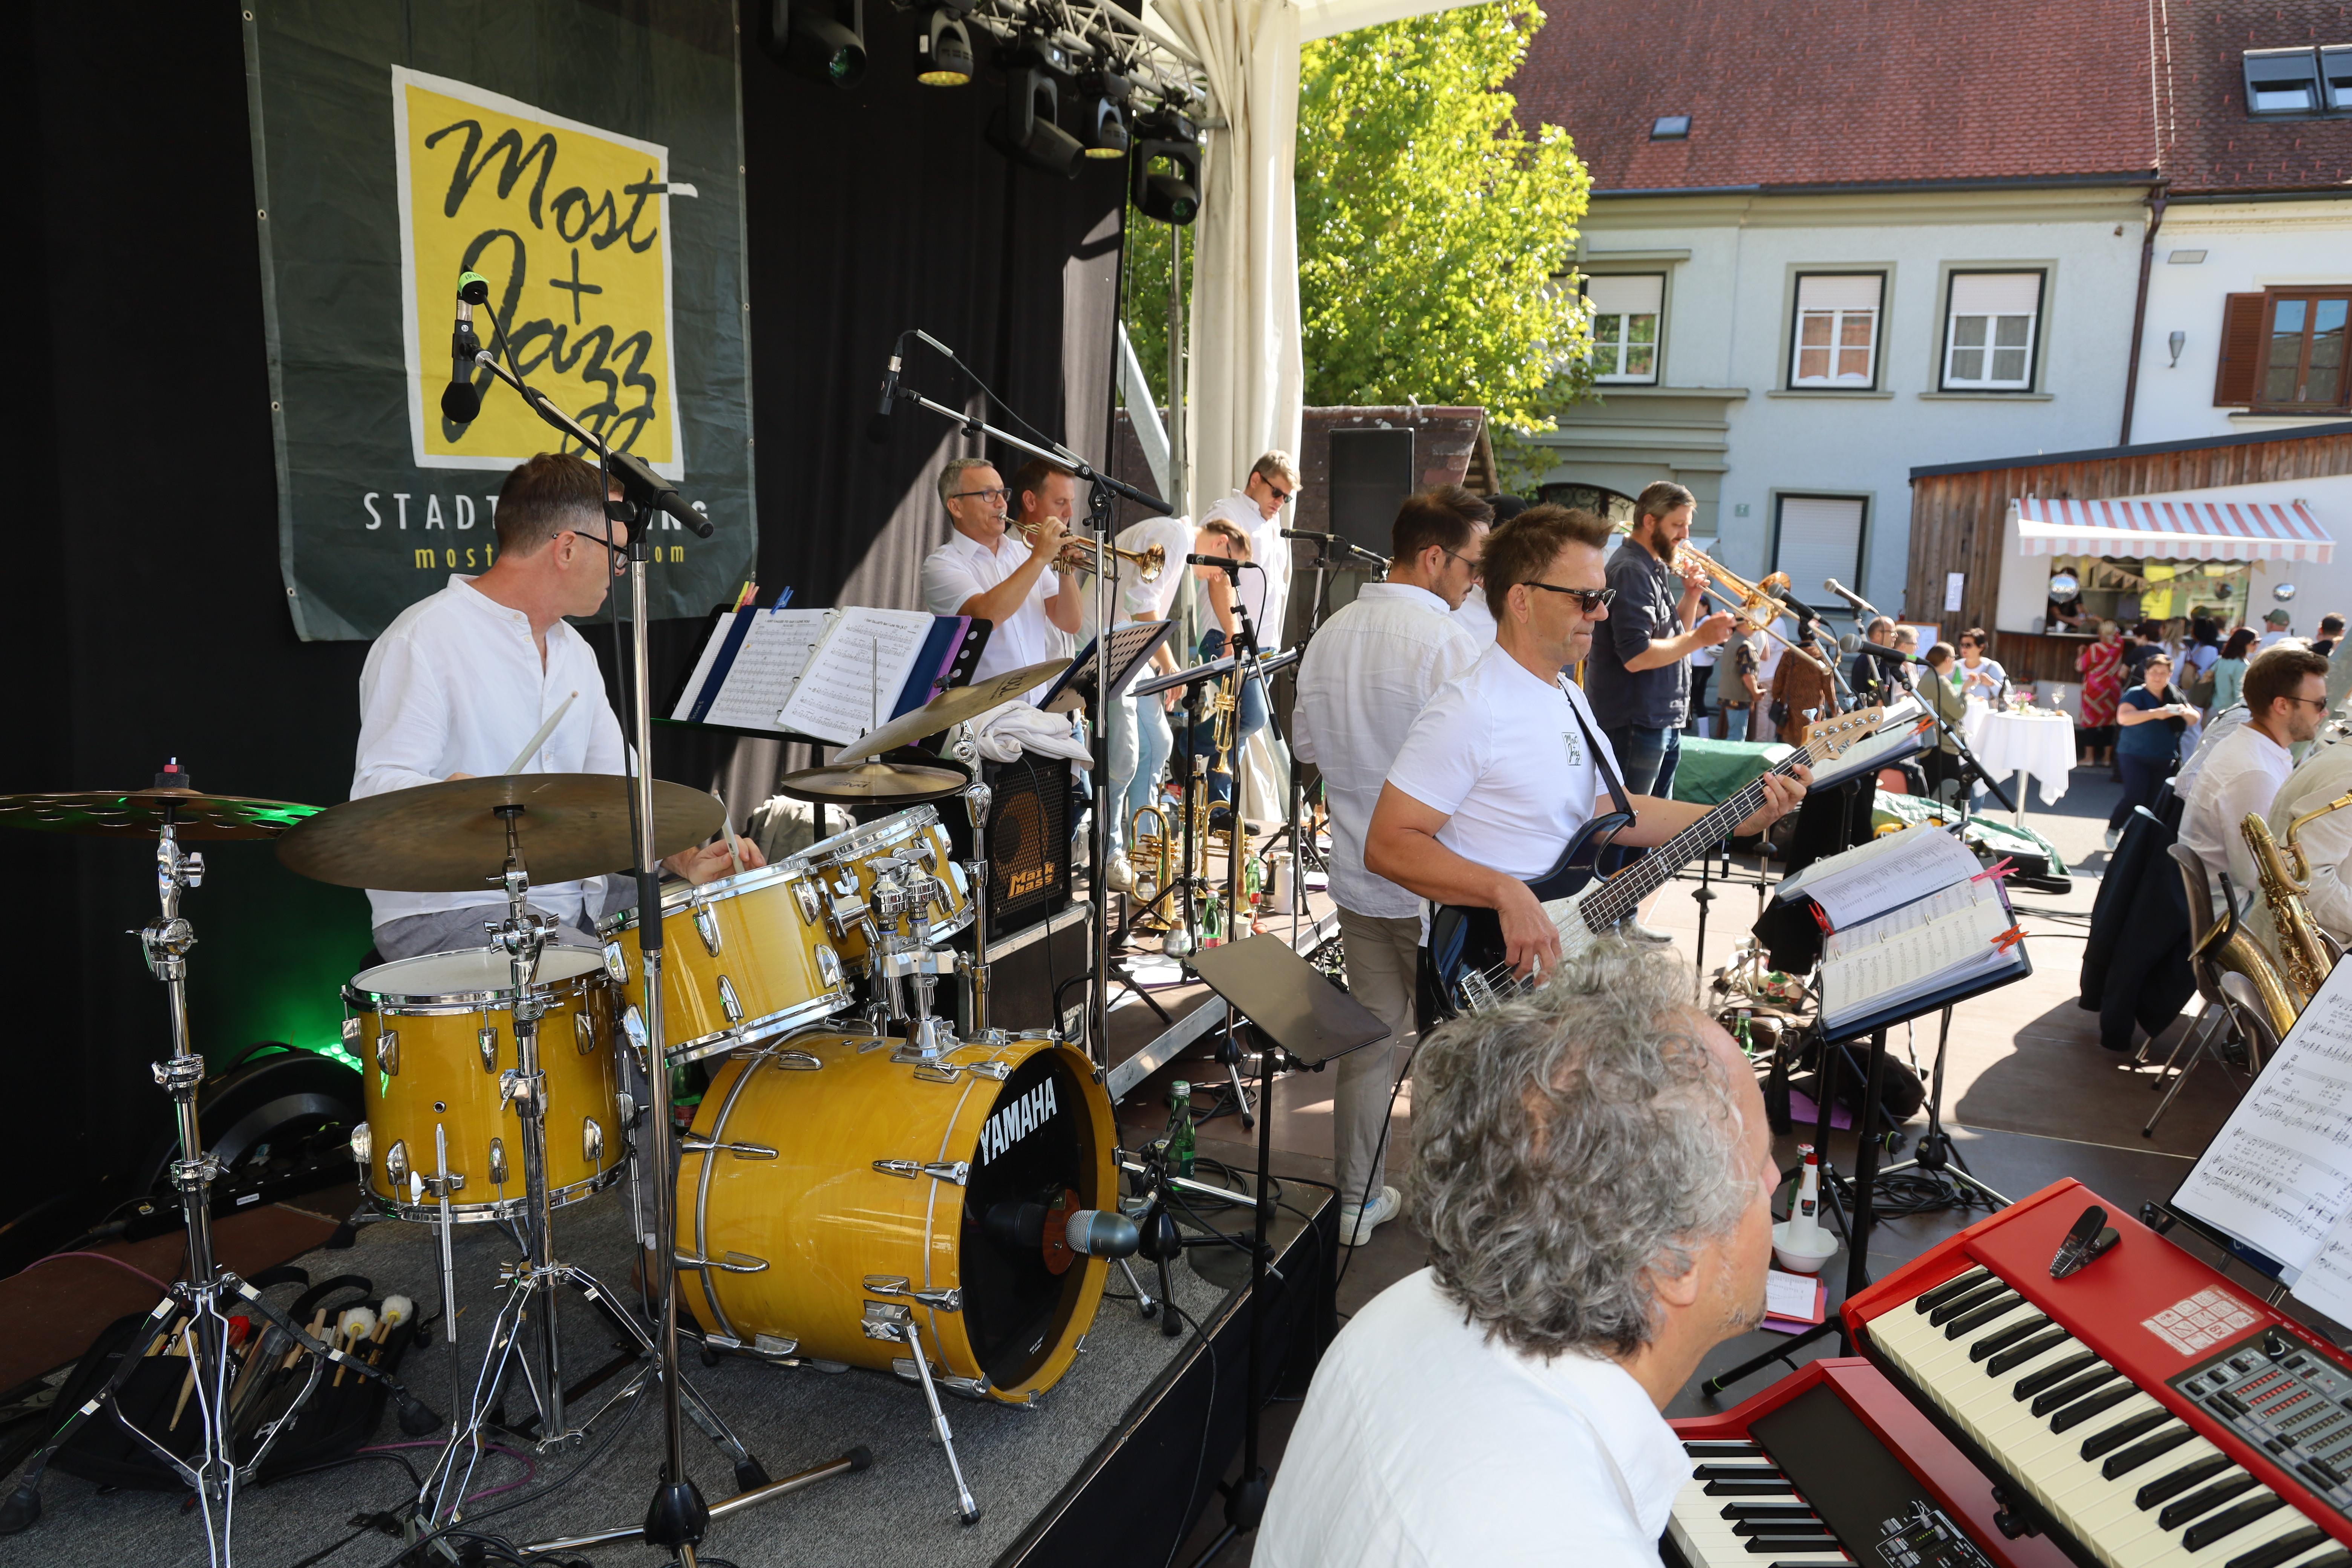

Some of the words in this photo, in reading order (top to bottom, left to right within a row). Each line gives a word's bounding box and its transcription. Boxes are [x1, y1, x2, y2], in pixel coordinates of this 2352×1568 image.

[424, 119, 698, 253] Most
[549, 248, 602, 325] +
[441, 228, 656, 457] Jazz
[1565, 734, 1577, 744] Most
[1568, 743, 1580, 765] Jazz
[1008, 862, 1054, 898] Mark
[1015, 874, 1053, 895] bass
[980, 1077, 1057, 1166] YAMAHA
[1943, 1518, 1954, 1530] PIANO
